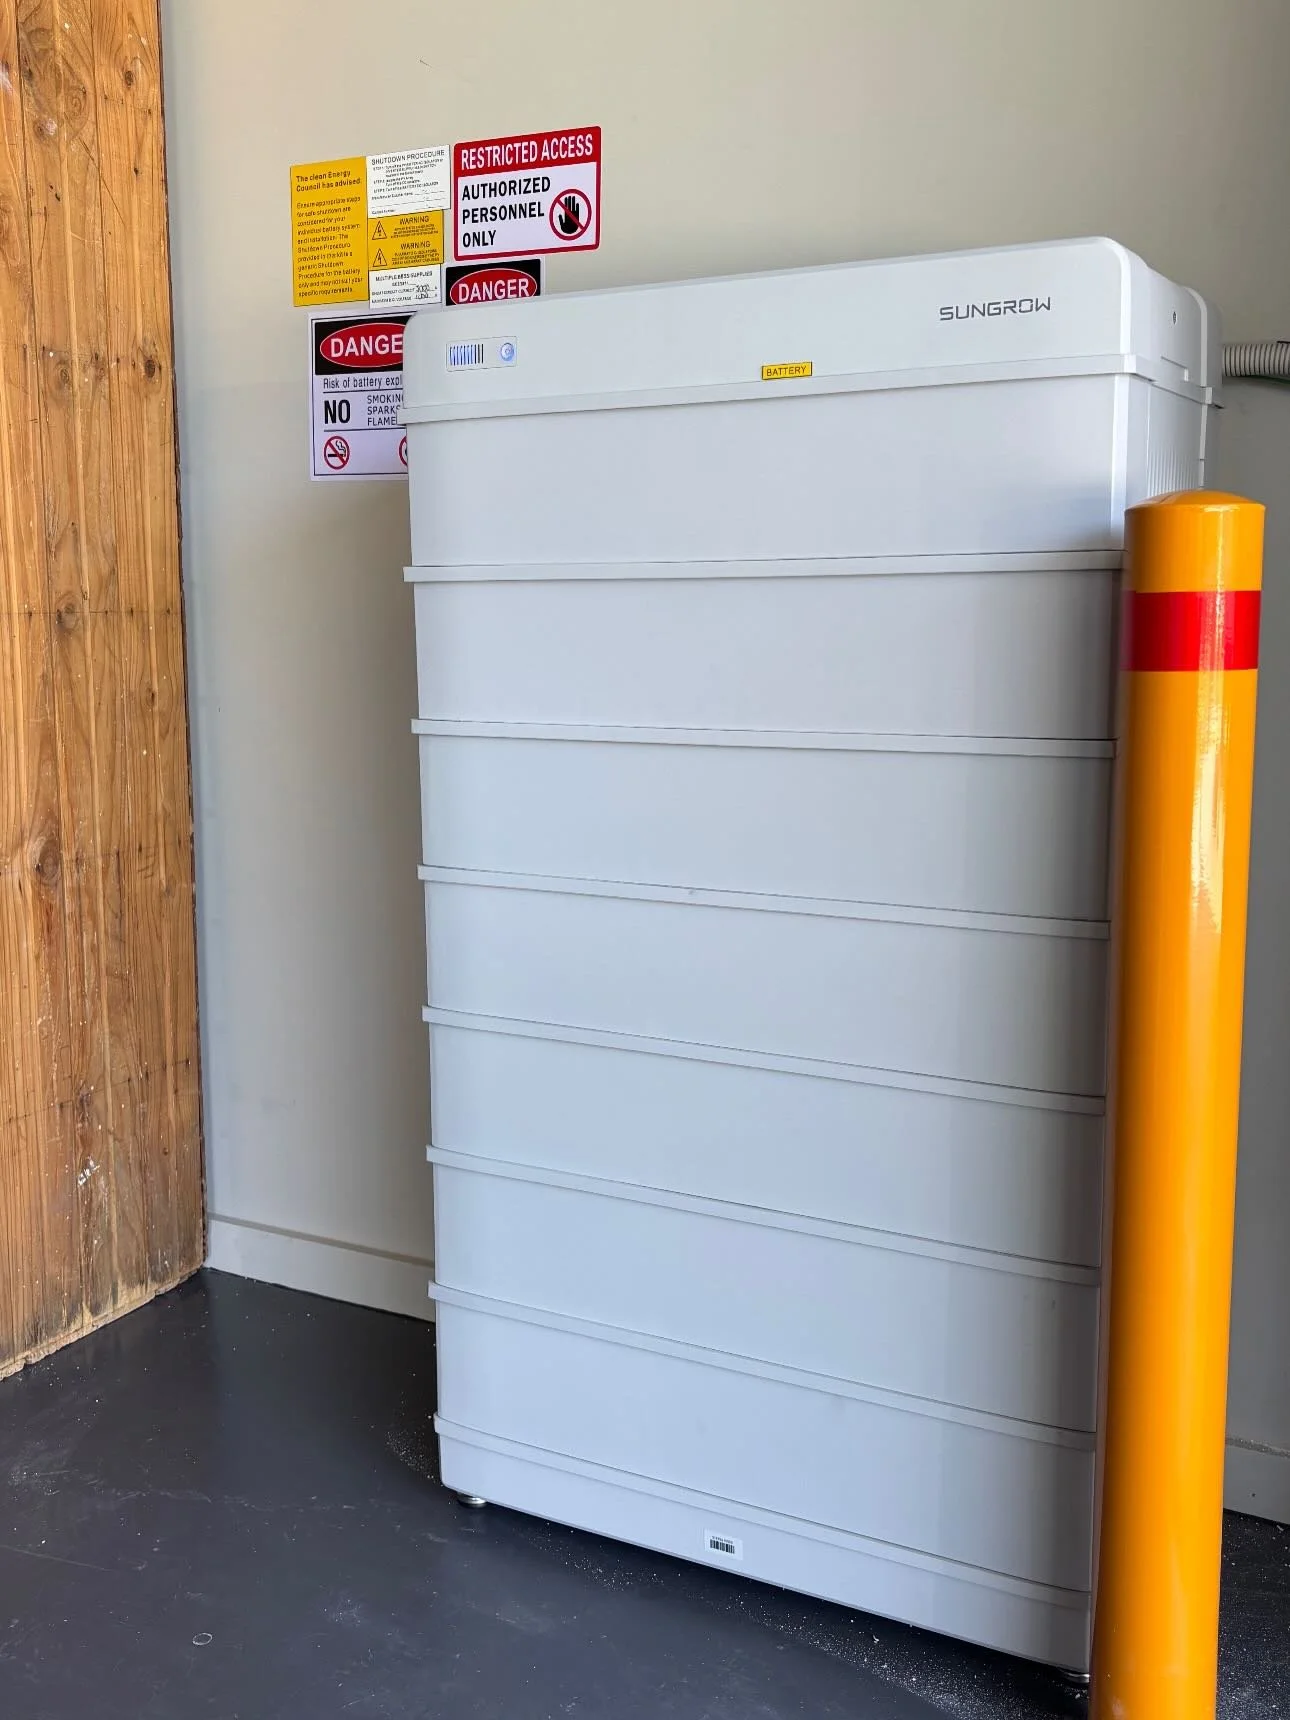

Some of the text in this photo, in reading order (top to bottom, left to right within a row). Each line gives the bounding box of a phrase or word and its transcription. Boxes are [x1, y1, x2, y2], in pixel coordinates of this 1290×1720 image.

[372, 156, 406, 165] SHUTDOWN
[407, 150, 444, 160] PROCEDURE
[462, 140, 538, 170] RESTRICTED
[541, 134, 593, 161] ACCESS
[328, 170, 350, 178] Energy
[296, 182, 320, 192] Council
[462, 176, 551, 200] AUTHORIZED
[462, 201, 544, 224] PERSONNEL
[400, 216, 430, 225] WARNING
[401, 240, 431, 249] WARNING
[462, 230, 496, 248] ONLY
[375, 274, 397, 282] MULTIPLE
[458, 278, 530, 302] DANGER
[940, 297, 1050, 320] SUNGROW
[330, 334, 403, 358] DANGE
[766, 366, 806, 376] BATTERY
[324, 378, 340, 389] Risk
[343, 377, 350, 388] of
[353, 376, 382, 389] battery
[367, 394, 403, 404] SMOKIN
[324, 400, 350, 424] NO
